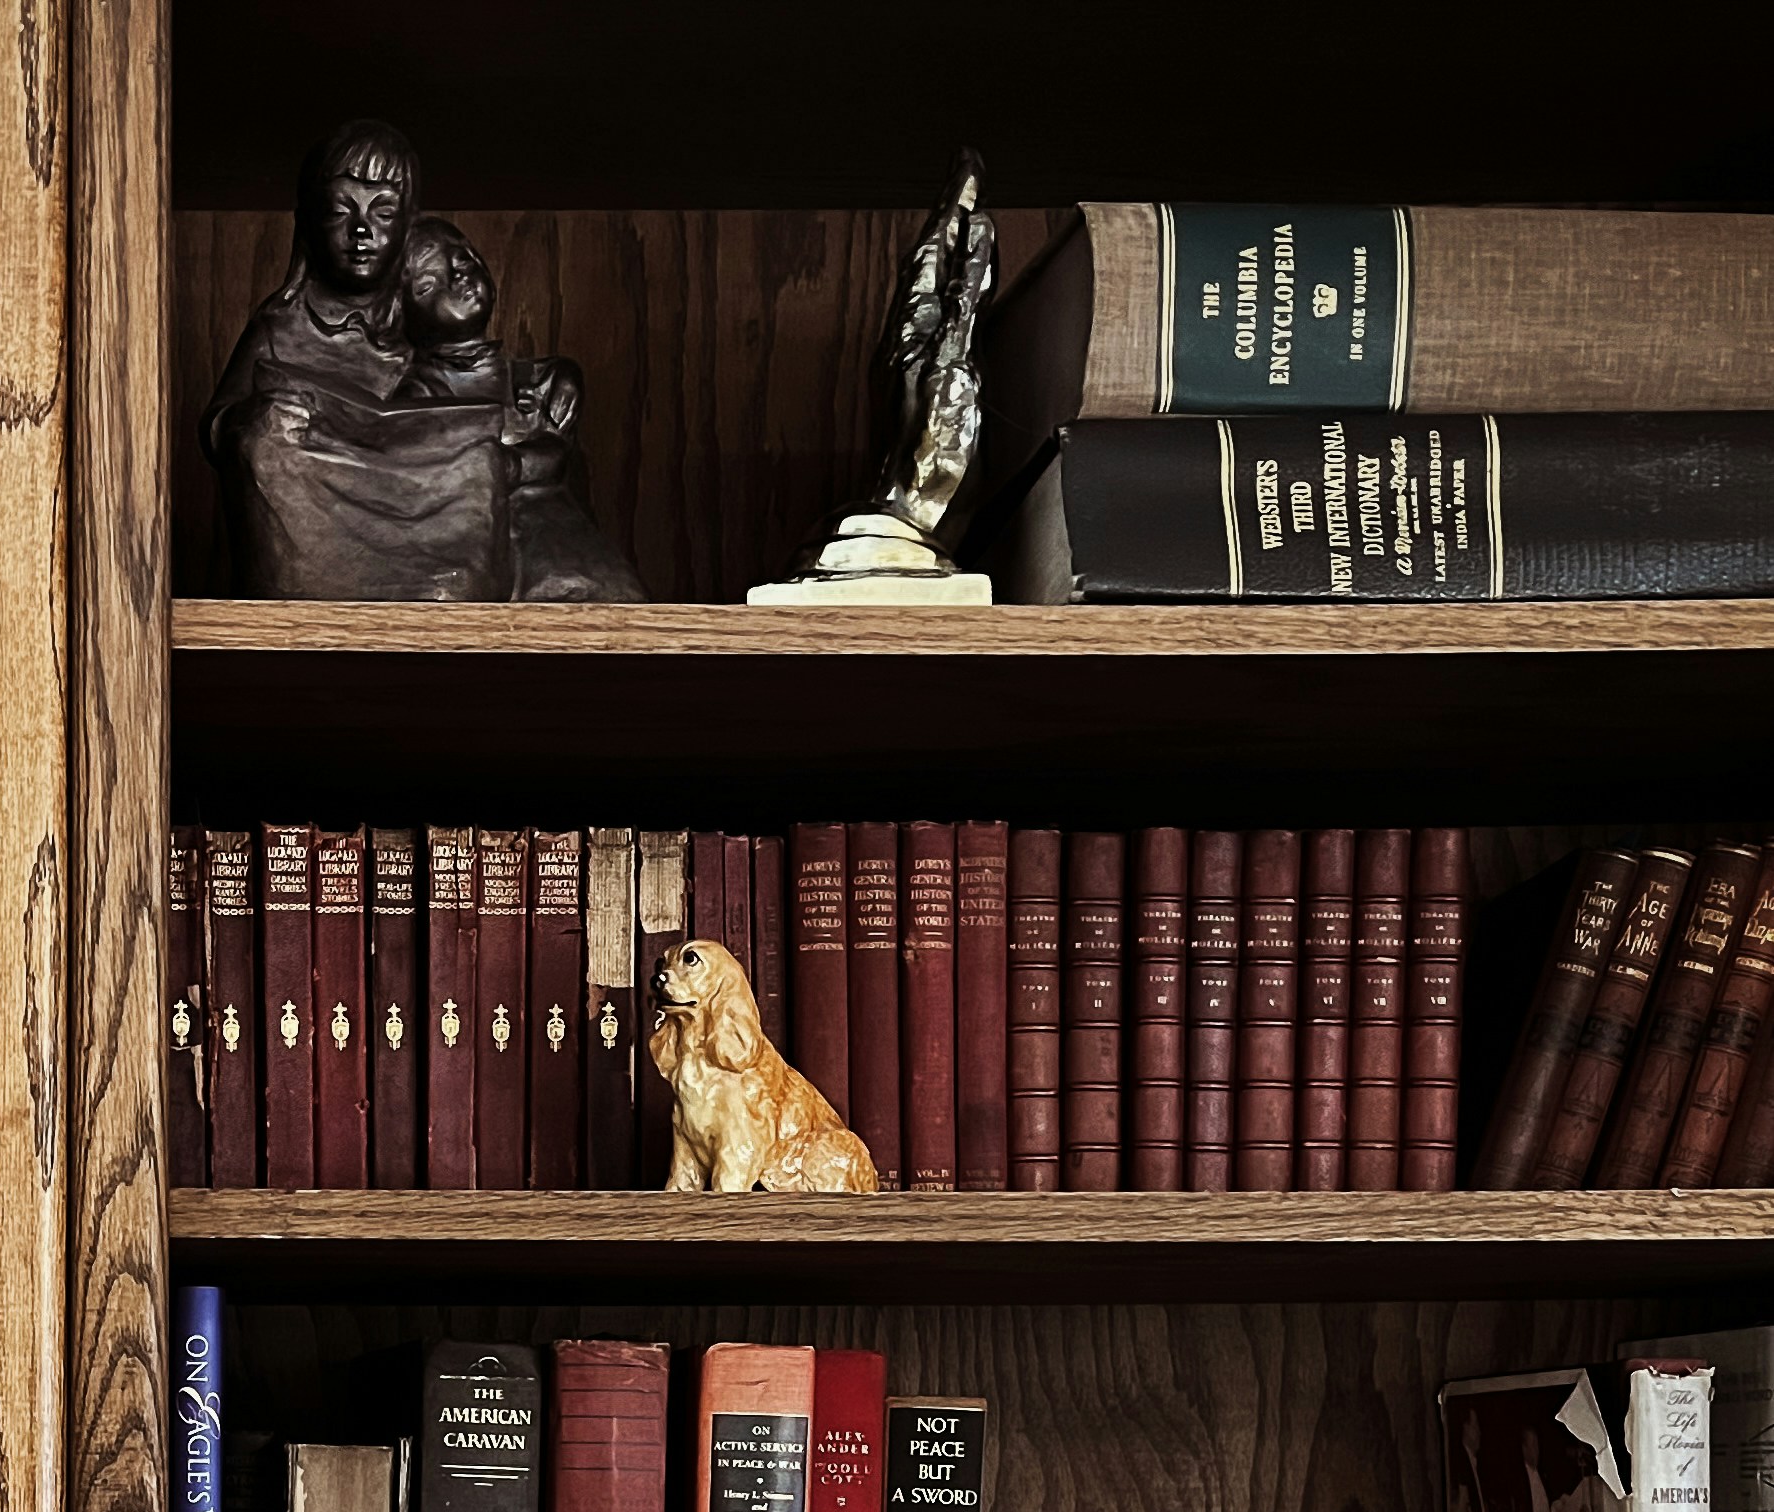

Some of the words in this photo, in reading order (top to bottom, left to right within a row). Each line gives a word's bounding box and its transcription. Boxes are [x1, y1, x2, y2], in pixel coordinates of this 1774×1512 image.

[1354, 247, 1366, 303] VOLUME
[1203, 282, 1220, 318] THE
[1234, 246, 1258, 359] COLUMBIA
[1269, 224, 1294, 385] ENCYCLOPEDIA
[1352, 308, 1365, 338] ONE
[1350, 344, 1363, 360] IN
[1321, 421, 1350, 547] INTERNATIONAL
[1454, 459, 1466, 506] PAPER
[1256, 460, 1283, 549] WEBSTER'S
[1290, 481, 1315, 532] THIRD
[1358, 454, 1384, 555] DICTIONARY
[1455, 508, 1467, 549] INDIA
[1434, 531, 1445, 581] LATEST
[1330, 549, 1352, 595] NEW
[280, 835, 297, 845] THE
[269, 859, 307, 872] LIBRARY
[271, 884, 307, 893] STORIES
[798, 877, 842, 887] GENERAL
[1650, 881, 1671, 894] THE
[799, 892, 842, 902] HISTORY
[1582, 890, 1618, 915] THIRTY
[1629, 892, 1670, 919] AGE
[803, 919, 841, 928] WORLD
[1575, 908, 1610, 931] YEARS
[1575, 929, 1600, 955] WAR
[1615, 925, 1659, 956] ANNE
[185, 1335, 209, 1382] ON
[473, 1388, 504, 1400] THE
[439, 1407, 532, 1425] AMERICAN
[916, 1417, 959, 1434] NOT
[752, 1425, 770, 1435] ON
[178, 1387, 220, 1504] EAGLE'S
[444, 1432, 526, 1450] CARAVAN
[714, 1442, 757, 1451] ACTIVE
[760, 1442, 804, 1453] SERVICE
[910, 1440, 965, 1458] PEACE
[718, 1459, 729, 1467] IN
[733, 1460, 764, 1469] PEACE
[767, 1461, 776, 1469] &
[779, 1461, 801, 1470] WAR
[918, 1464, 955, 1481] BUT
[1677, 1456, 1695, 1476] of
[892, 1488, 905, 1503] A
[911, 1488, 978, 1506] SWORD
[1651, 1488, 1708, 1504] AMERICA'S
